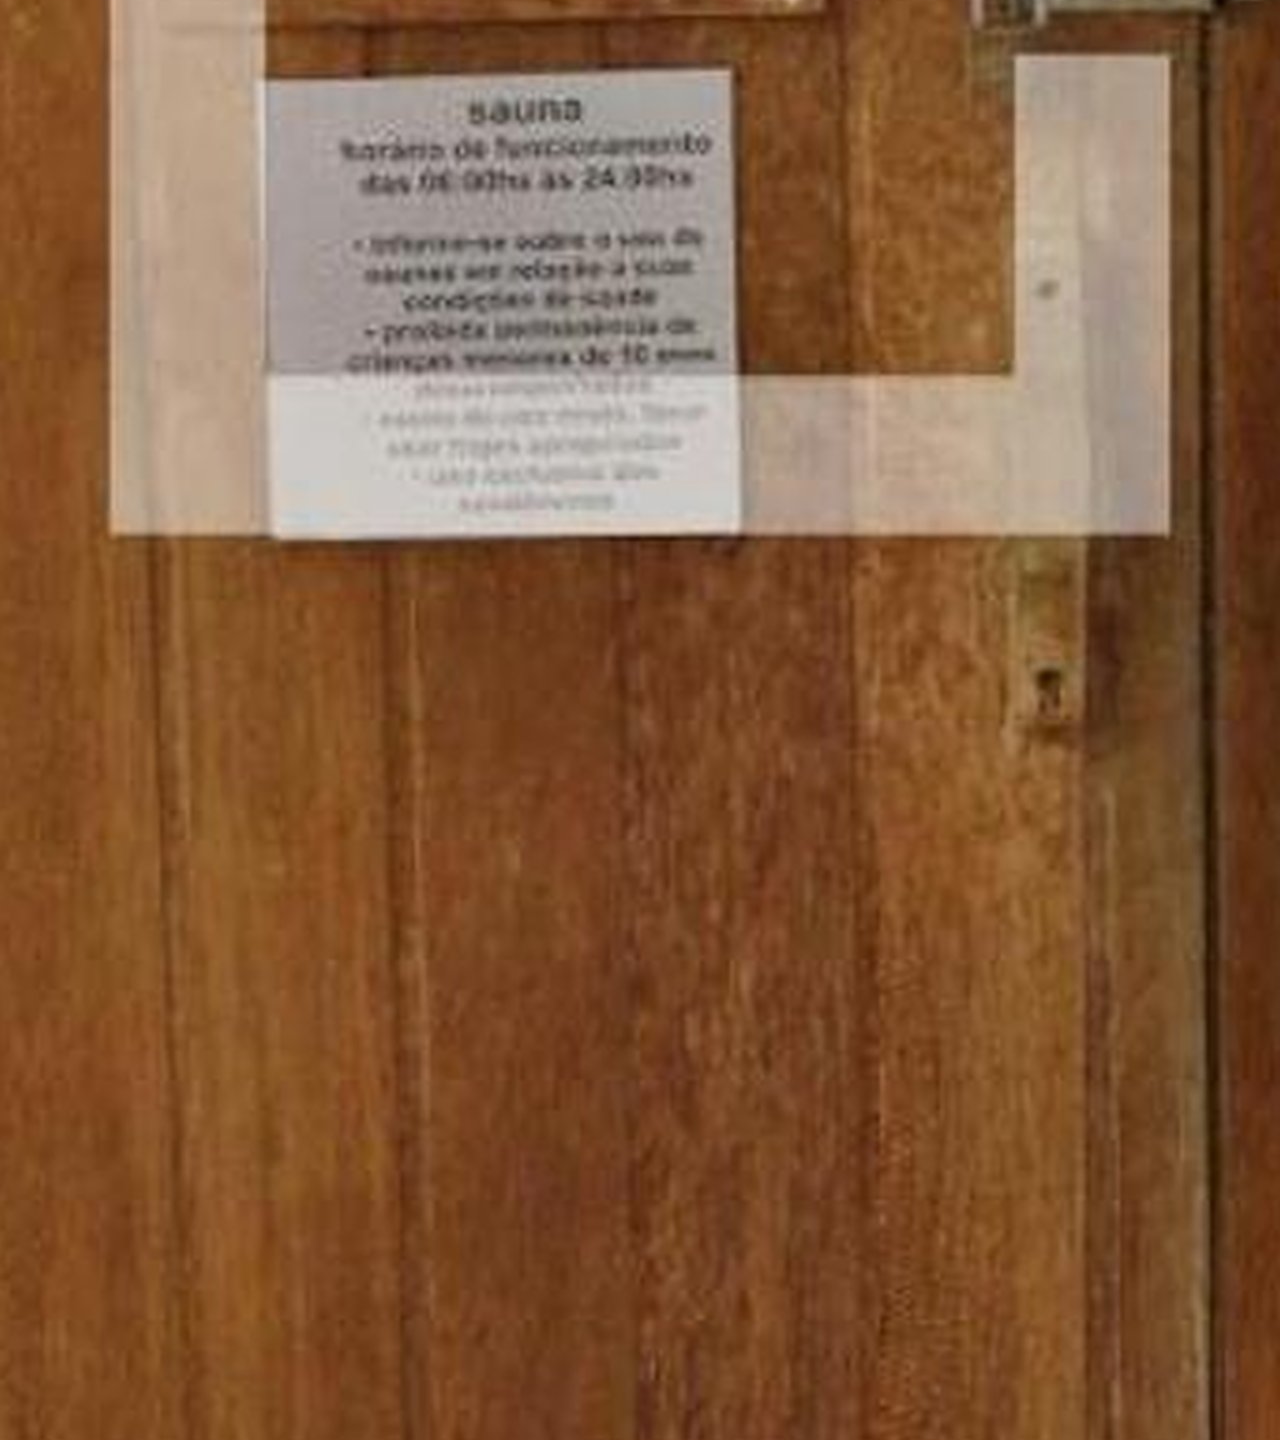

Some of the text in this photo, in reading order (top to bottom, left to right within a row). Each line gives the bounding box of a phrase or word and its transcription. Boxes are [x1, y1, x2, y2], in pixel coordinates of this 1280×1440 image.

[468, 98, 583, 125] sauna
[454, 138, 485, 158] de
[494, 132, 713, 159] funcionamento
[580, 346, 611, 365] de
